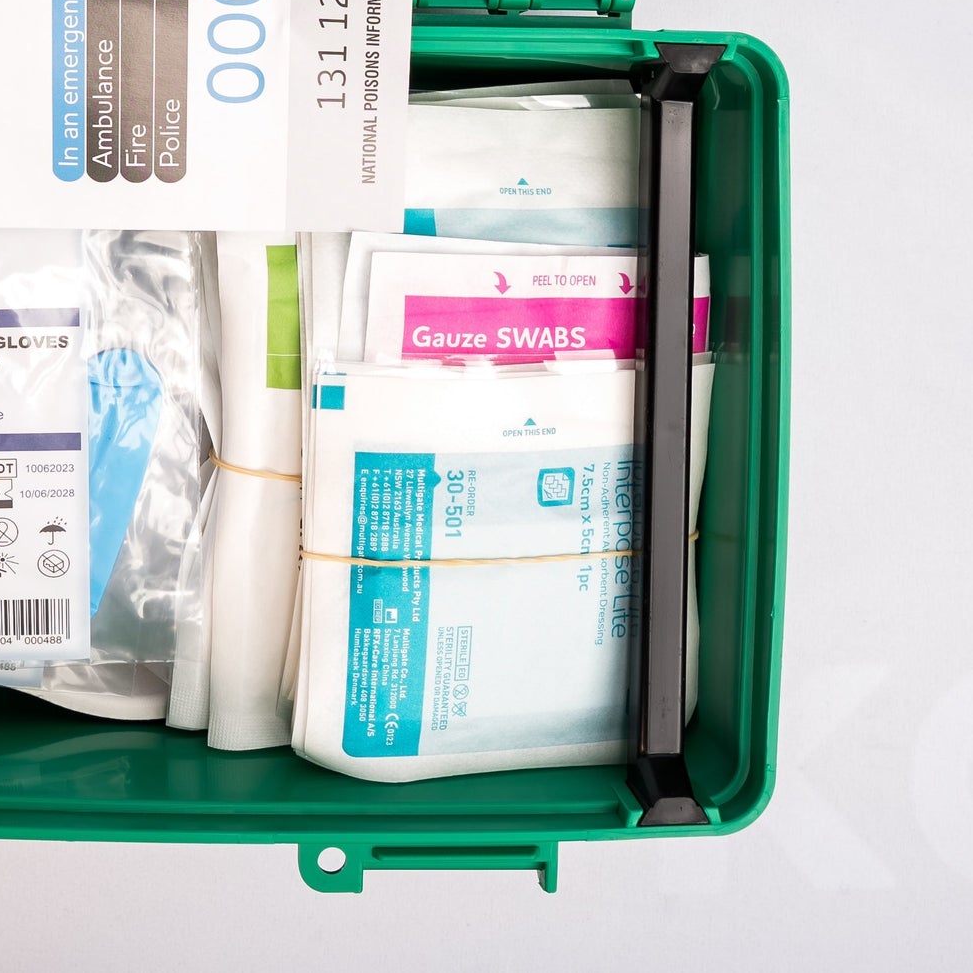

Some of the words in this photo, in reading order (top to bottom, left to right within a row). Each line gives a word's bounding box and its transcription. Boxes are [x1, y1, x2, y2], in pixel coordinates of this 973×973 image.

[317, 45, 347, 109] 131
[364, 50, 379, 111] POISONS
[62, 111, 79, 140] an
[91, 38, 114, 169] Ambulance
[125, 123, 147, 167] Fire
[159, 98, 181, 167] Police
[361, 115, 377, 184] NATIONAL
[58, 155, 79, 167] In
[533, 275, 552, 286] PEEL
[555, 275, 567, 286] TO
[569, 275, 596, 286] OPEN
[413, 325, 487, 348] Gauze
[495, 326, 585, 349] SWABS
[25, 463, 75, 474] 10062023
[580, 463, 595, 511] 7.5cm
[19, 488, 75, 499] 10/06/2028
[445, 470, 465, 537] 30-501
[467, 470, 477, 517] RE-ORDER
[581, 515, 591, 524] x
[579, 565, 593, 591] 1pc
[611, 592, 631, 639] Lite
[24, 637, 63, 645] 000488
[382, 628, 391, 665] Shaoxing
[445, 627, 455, 671] STERILITY
[381, 665, 390, 687] China
[439, 671, 452, 731] GUARANTEED
